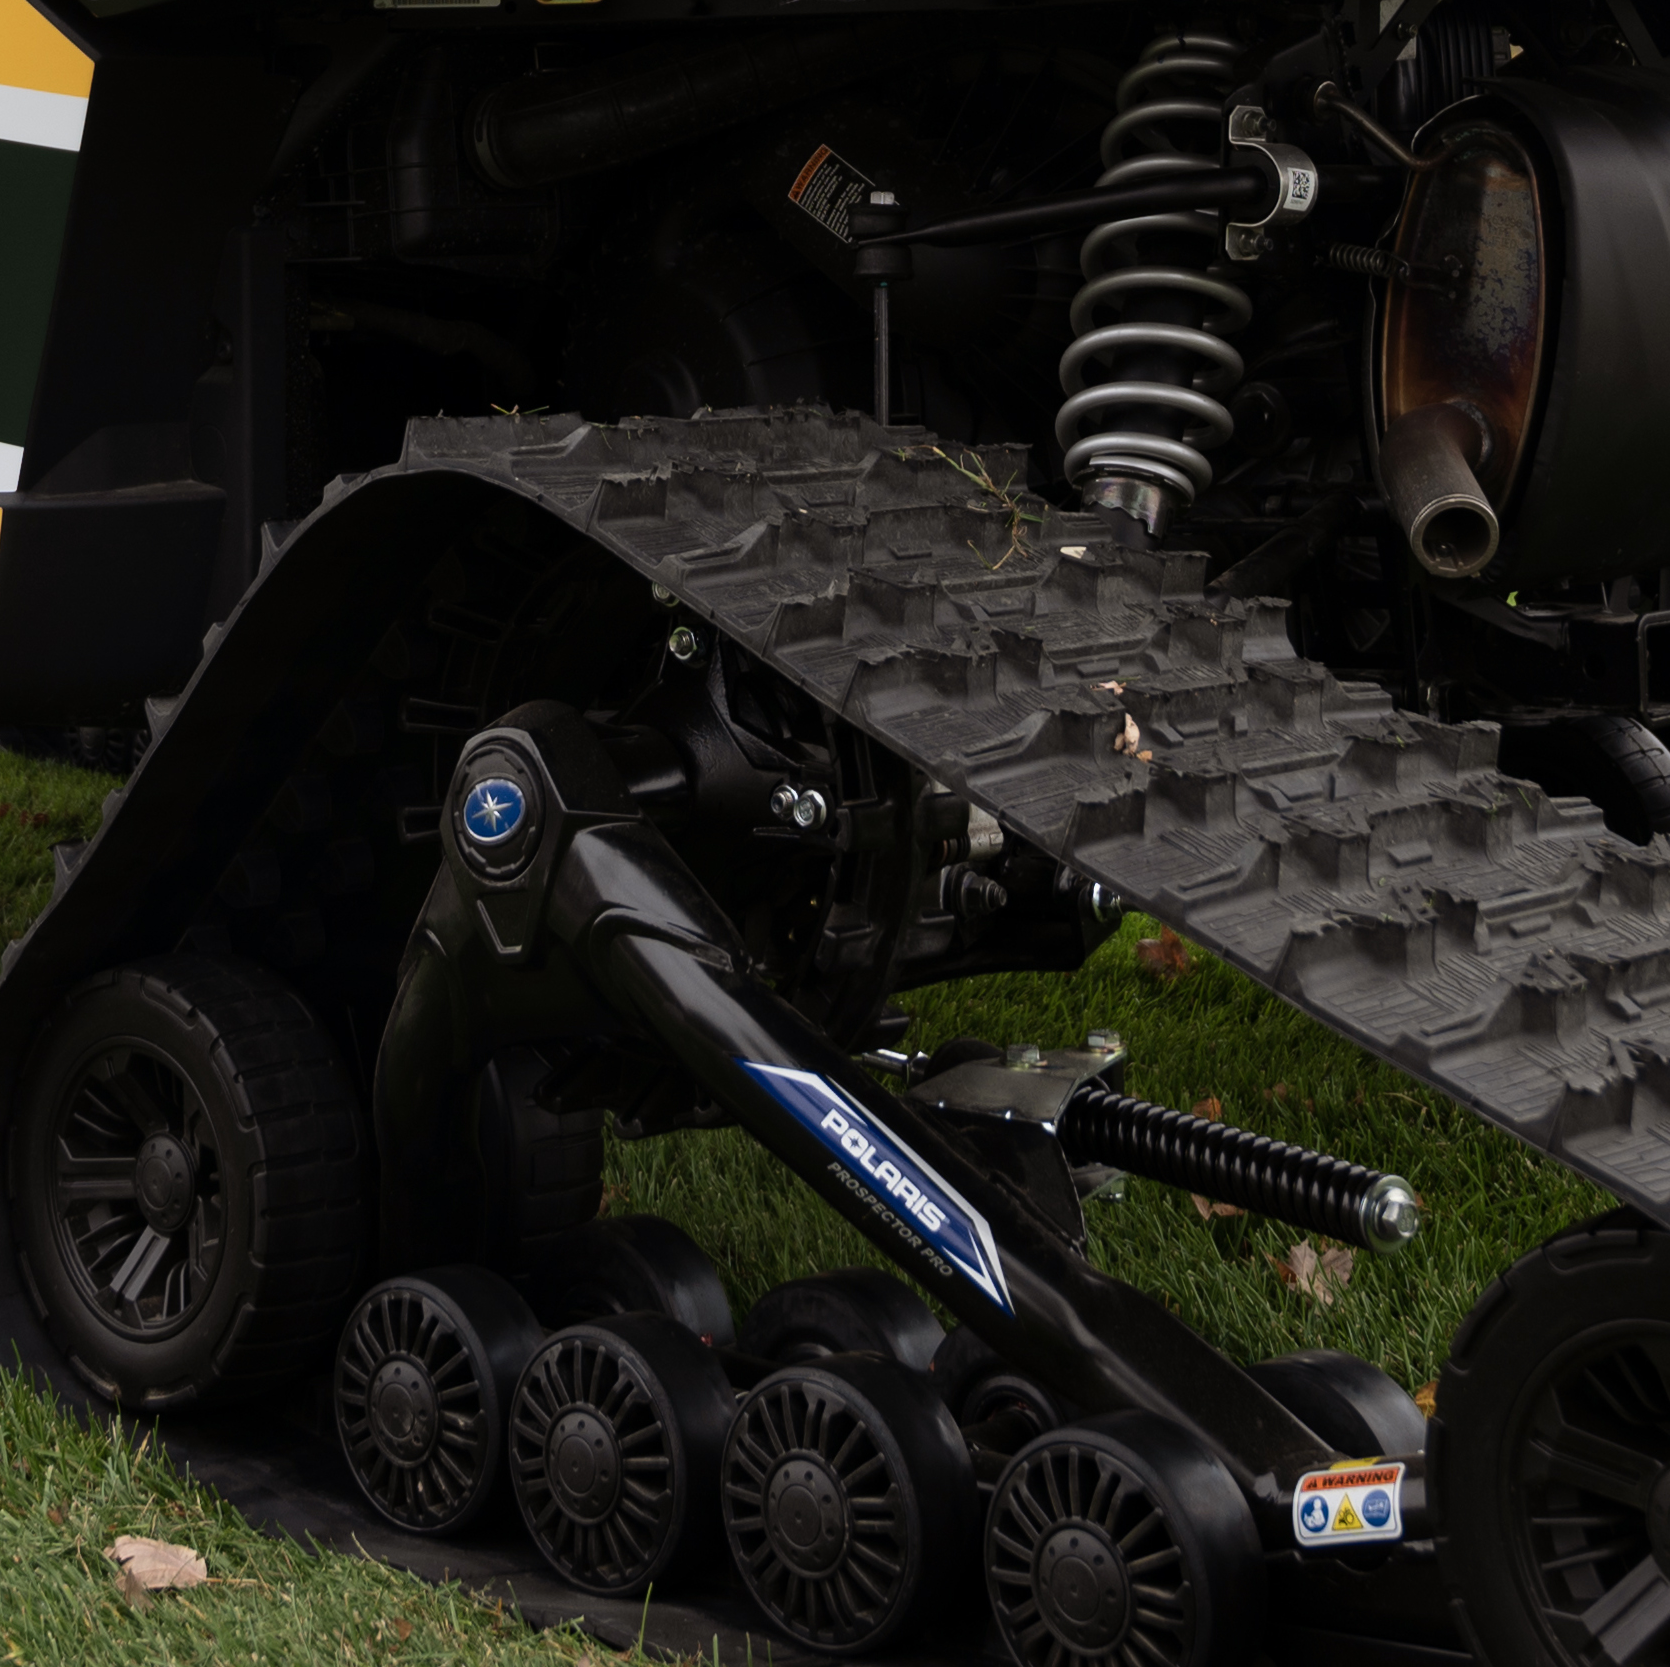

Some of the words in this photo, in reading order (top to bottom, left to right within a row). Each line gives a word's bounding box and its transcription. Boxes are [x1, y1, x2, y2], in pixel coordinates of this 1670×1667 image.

[796, 147, 828, 190] WARNING
[821, 1108, 942, 1233] POLARIS
[827, 1161, 923, 1249] PROSPECTOR
[920, 1246, 954, 1277] PRO
[1322, 1471, 1394, 1487] WARNING
